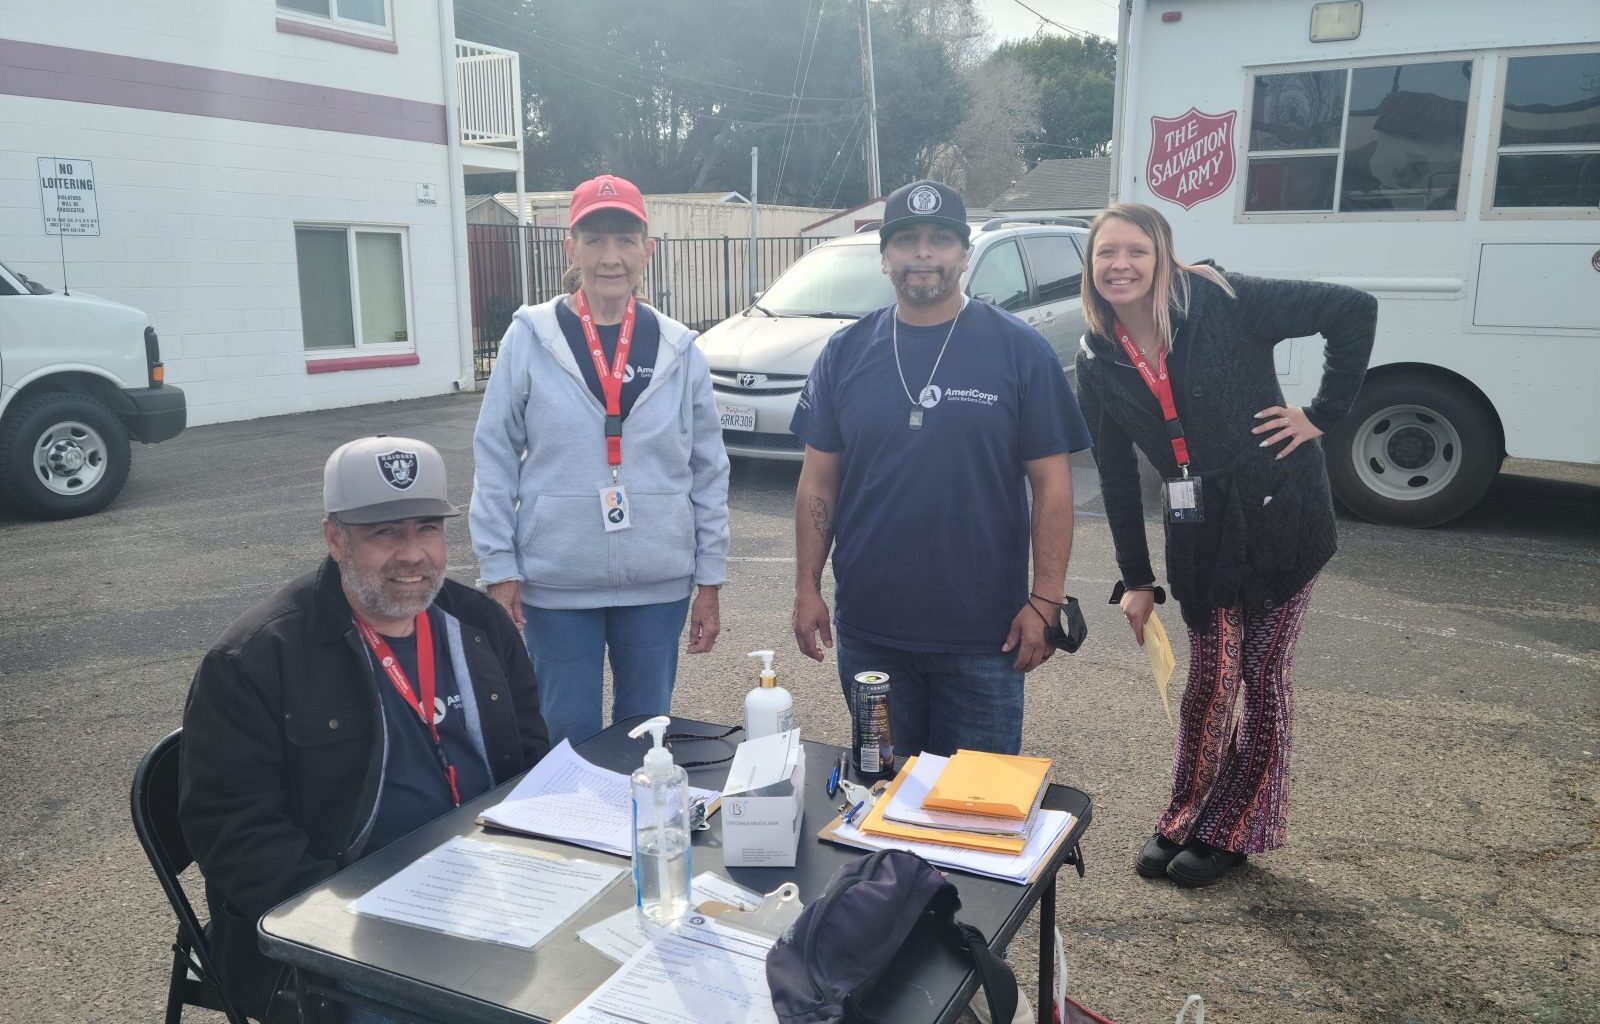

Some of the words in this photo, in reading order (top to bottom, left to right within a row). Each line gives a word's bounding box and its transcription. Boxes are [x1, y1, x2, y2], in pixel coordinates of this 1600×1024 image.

[1164, 119, 1199, 153] THE
[1152, 122, 1227, 186] SALVATION
[59, 163, 73, 175] NO
[1176, 150, 1224, 198] ARMY
[42, 177, 93, 190] LOITERING
[596, 178, 618, 196] A
[944, 387, 999, 402] AmeriCorps
[720, 414, 753, 428] 6RKR308
[381, 453, 414, 462] RAIDERS
